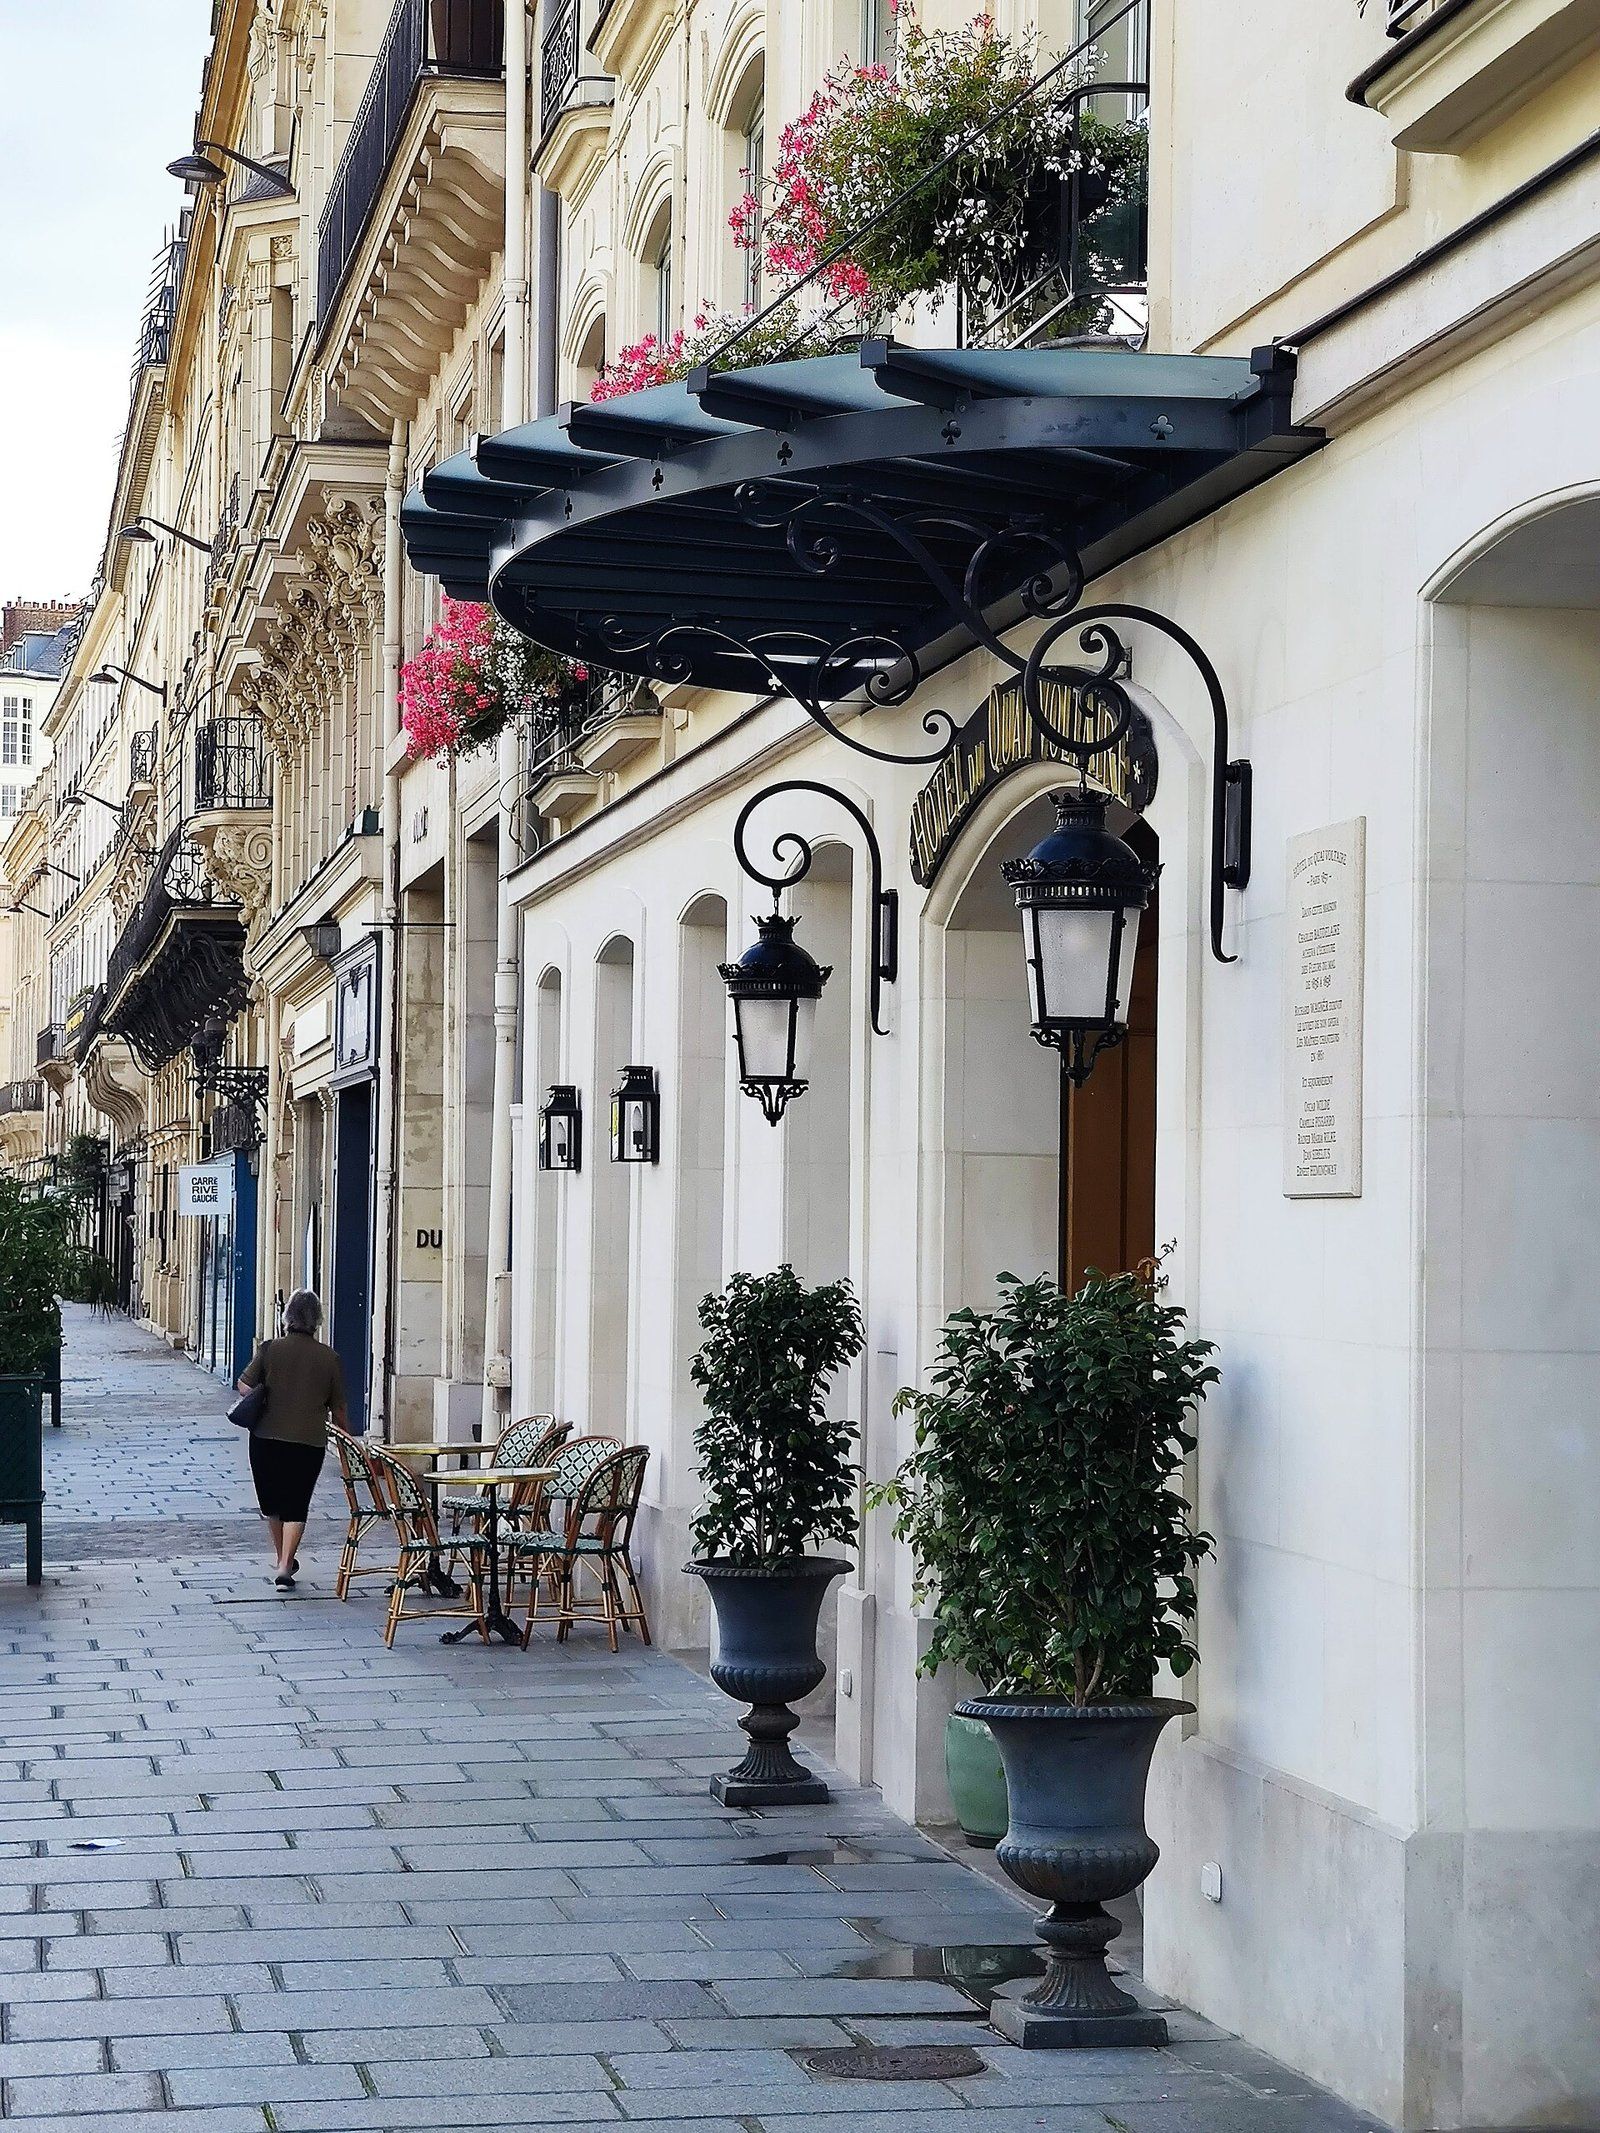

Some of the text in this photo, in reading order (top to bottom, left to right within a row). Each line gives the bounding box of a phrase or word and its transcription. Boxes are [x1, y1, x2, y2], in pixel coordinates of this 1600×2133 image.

[988, 683, 1033, 774] QUAI
[191, 1186, 218, 1194] RIVE
[191, 1194, 219, 1203] GAUCHE
[416, 1229, 443, 1249] DU
